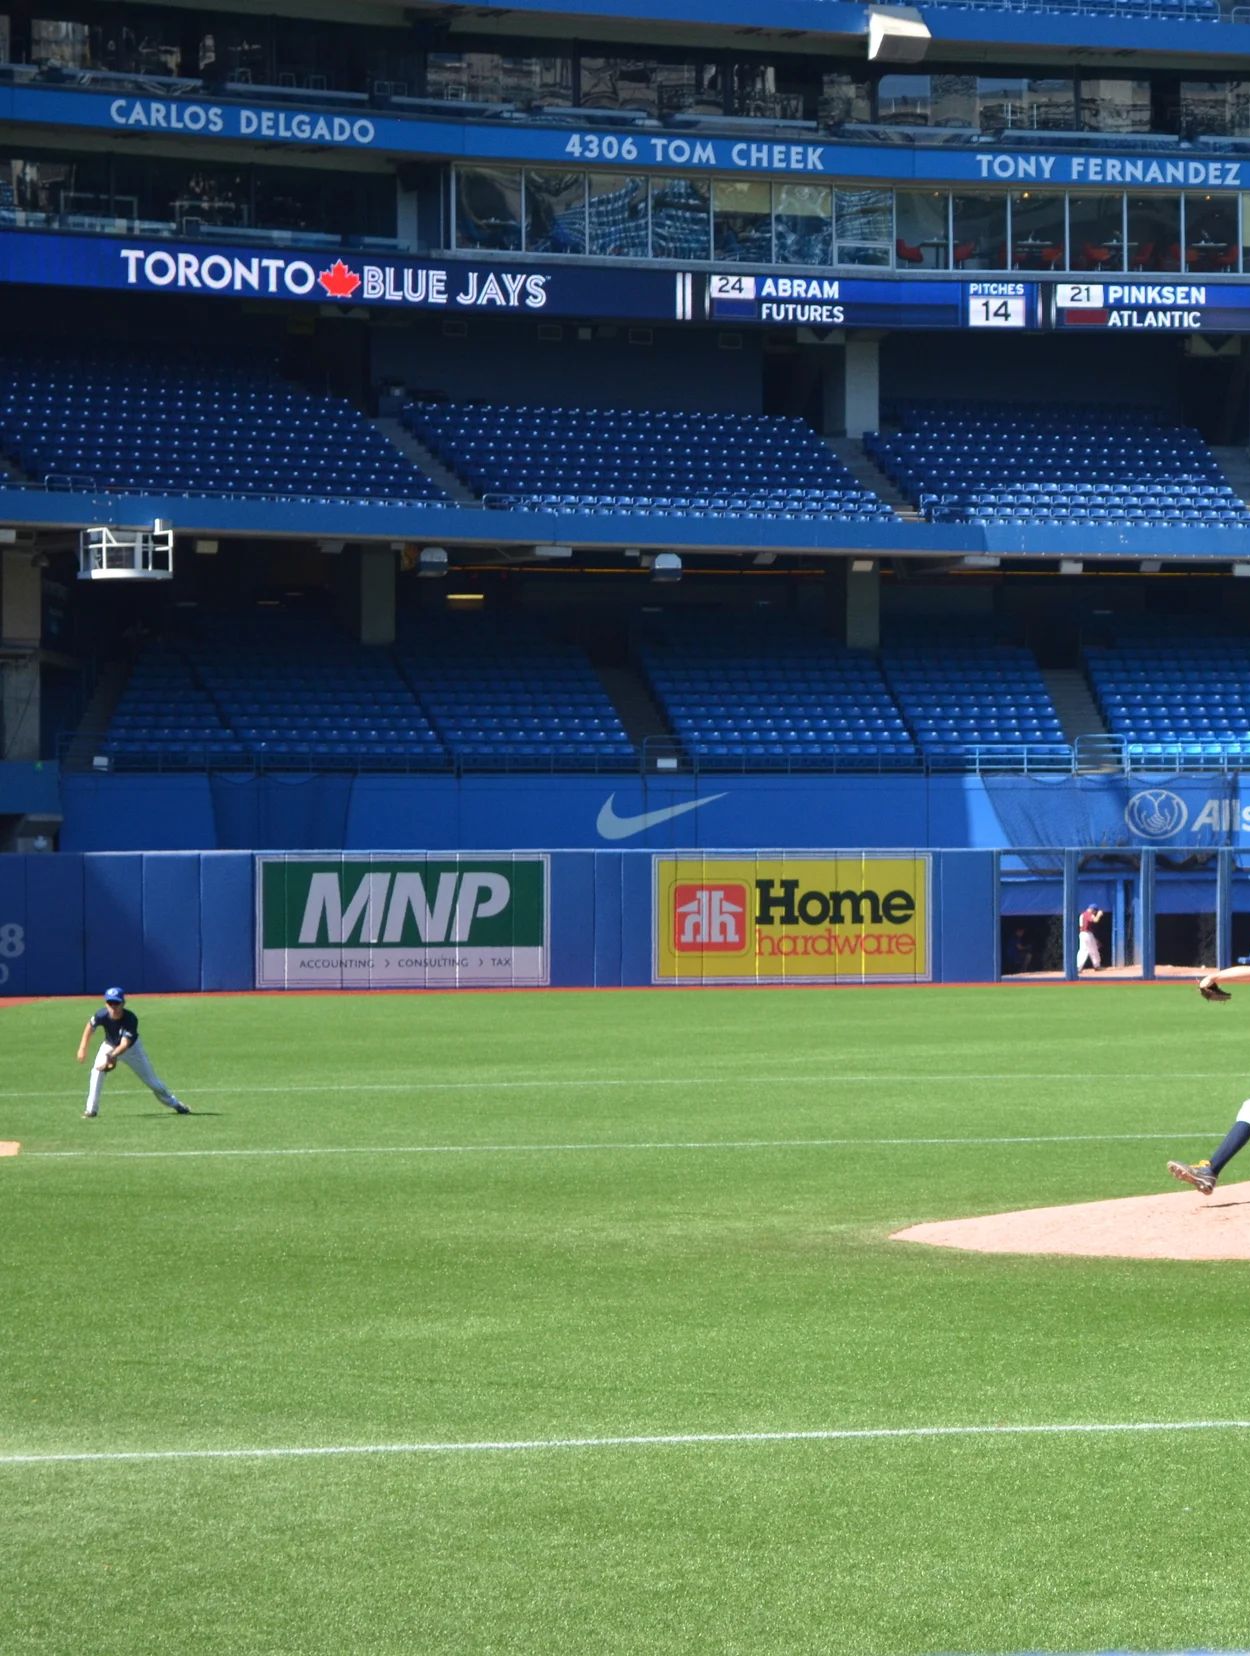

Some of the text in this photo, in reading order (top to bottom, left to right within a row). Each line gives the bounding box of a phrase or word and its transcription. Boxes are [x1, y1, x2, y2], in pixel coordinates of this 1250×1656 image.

[110, 99, 375, 143] CARLOS DELGADO
[565, 133, 825, 170] 4306 TOM CHEEK
[976, 155, 1241, 185] TONY FERNANDEZ
[120, 249, 547, 308] TORONTO BLUE JAYS
[718, 276, 839, 299] 24 ABRAM
[969, 283, 1024, 295] PITCHES
[1070, 286, 1206, 304] 21 PINKSEN
[761, 303, 844, 323] FUTURES
[982, 301, 1011, 322] 14
[1108, 311, 1201, 328] ATLANTIC
[298, 872, 511, 943] MNP
[755, 879, 915, 926] Home
[0, 923, 26, 958] 8
[755, 928, 916, 957] hardware
[299, 957, 511, 969] ACCOUNTING CONSULTING TAX
